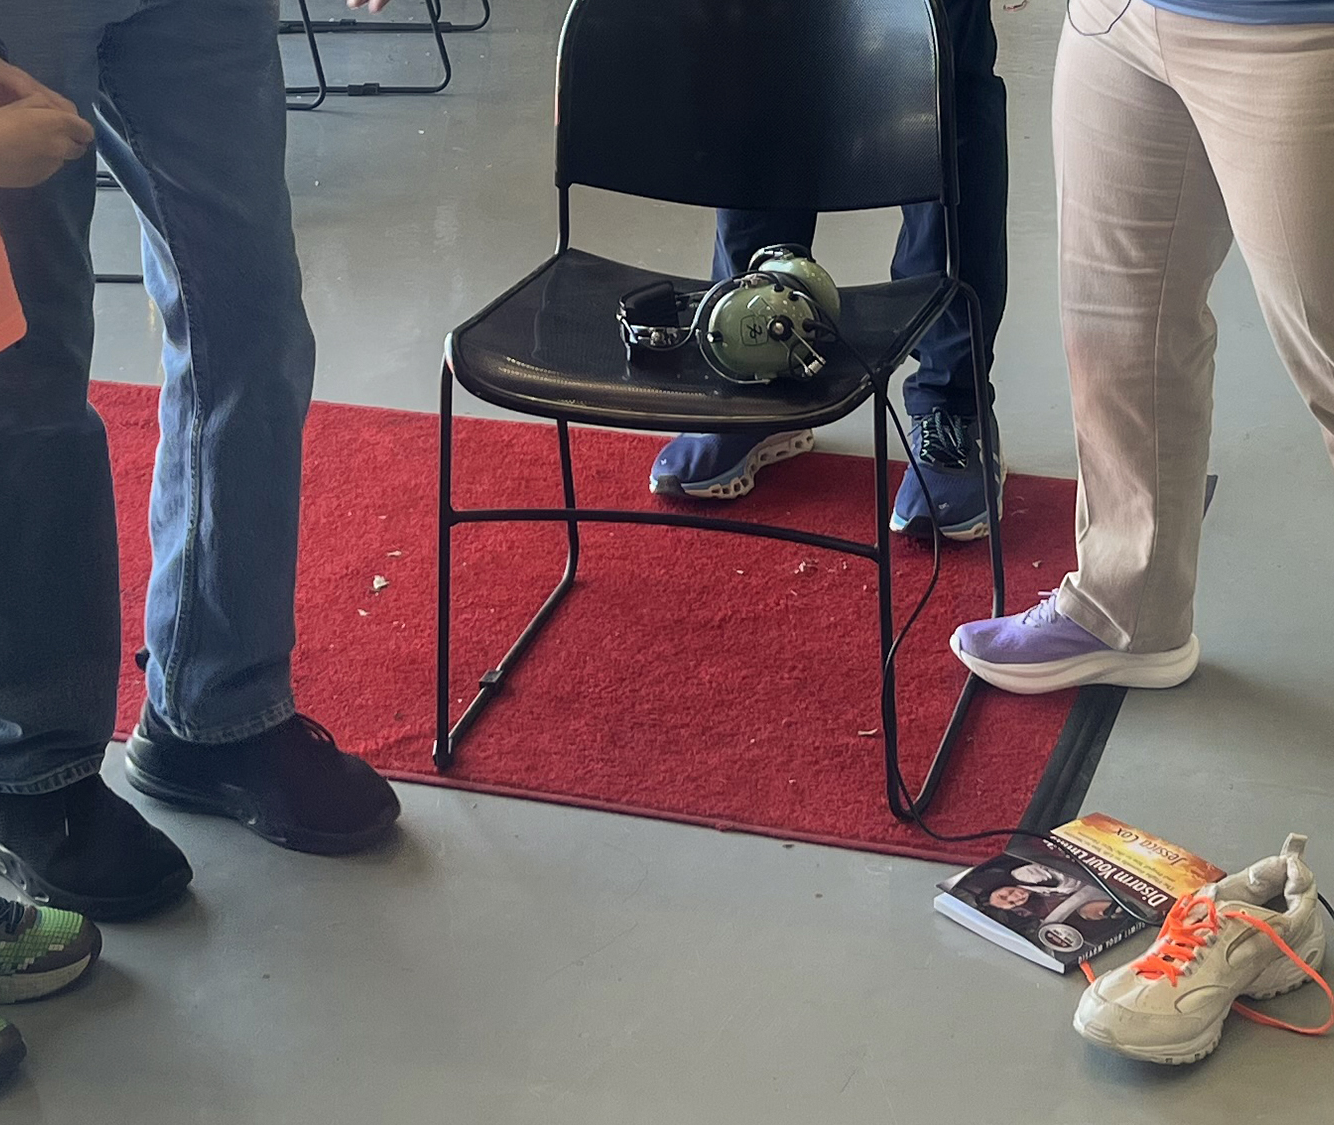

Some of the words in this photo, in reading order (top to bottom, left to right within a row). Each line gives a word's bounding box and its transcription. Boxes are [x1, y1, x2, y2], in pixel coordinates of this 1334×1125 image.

[1116, 827, 1139, 843] Cox
[1140, 839, 1188, 867] Jessica
[1087, 854, 1114, 881] Your
[1115, 870, 1169, 909] Disarm
